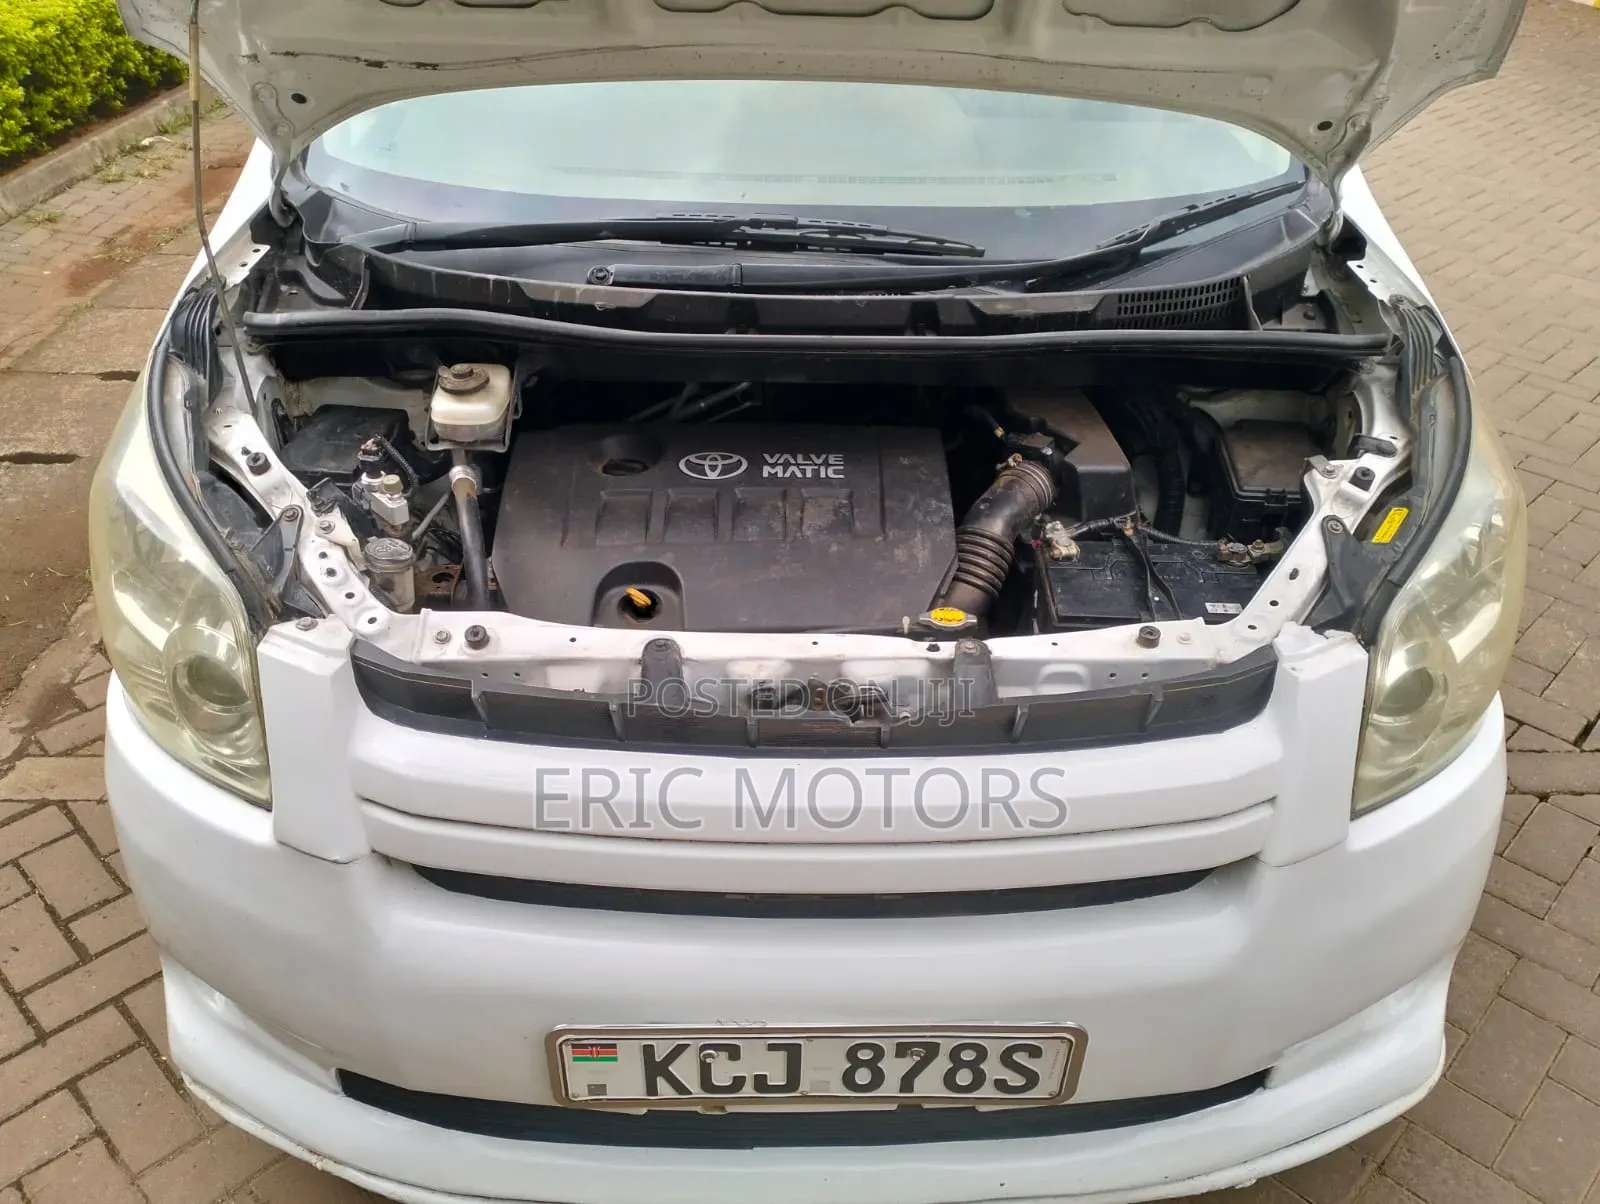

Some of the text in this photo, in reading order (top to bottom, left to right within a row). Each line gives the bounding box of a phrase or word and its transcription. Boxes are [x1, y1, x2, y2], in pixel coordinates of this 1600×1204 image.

[763, 453, 844, 465] VALVE
[762, 466, 845, 478] MATIC
[641, 1042, 802, 1097] KCJ
[841, 1041, 1044, 1095] 878S
